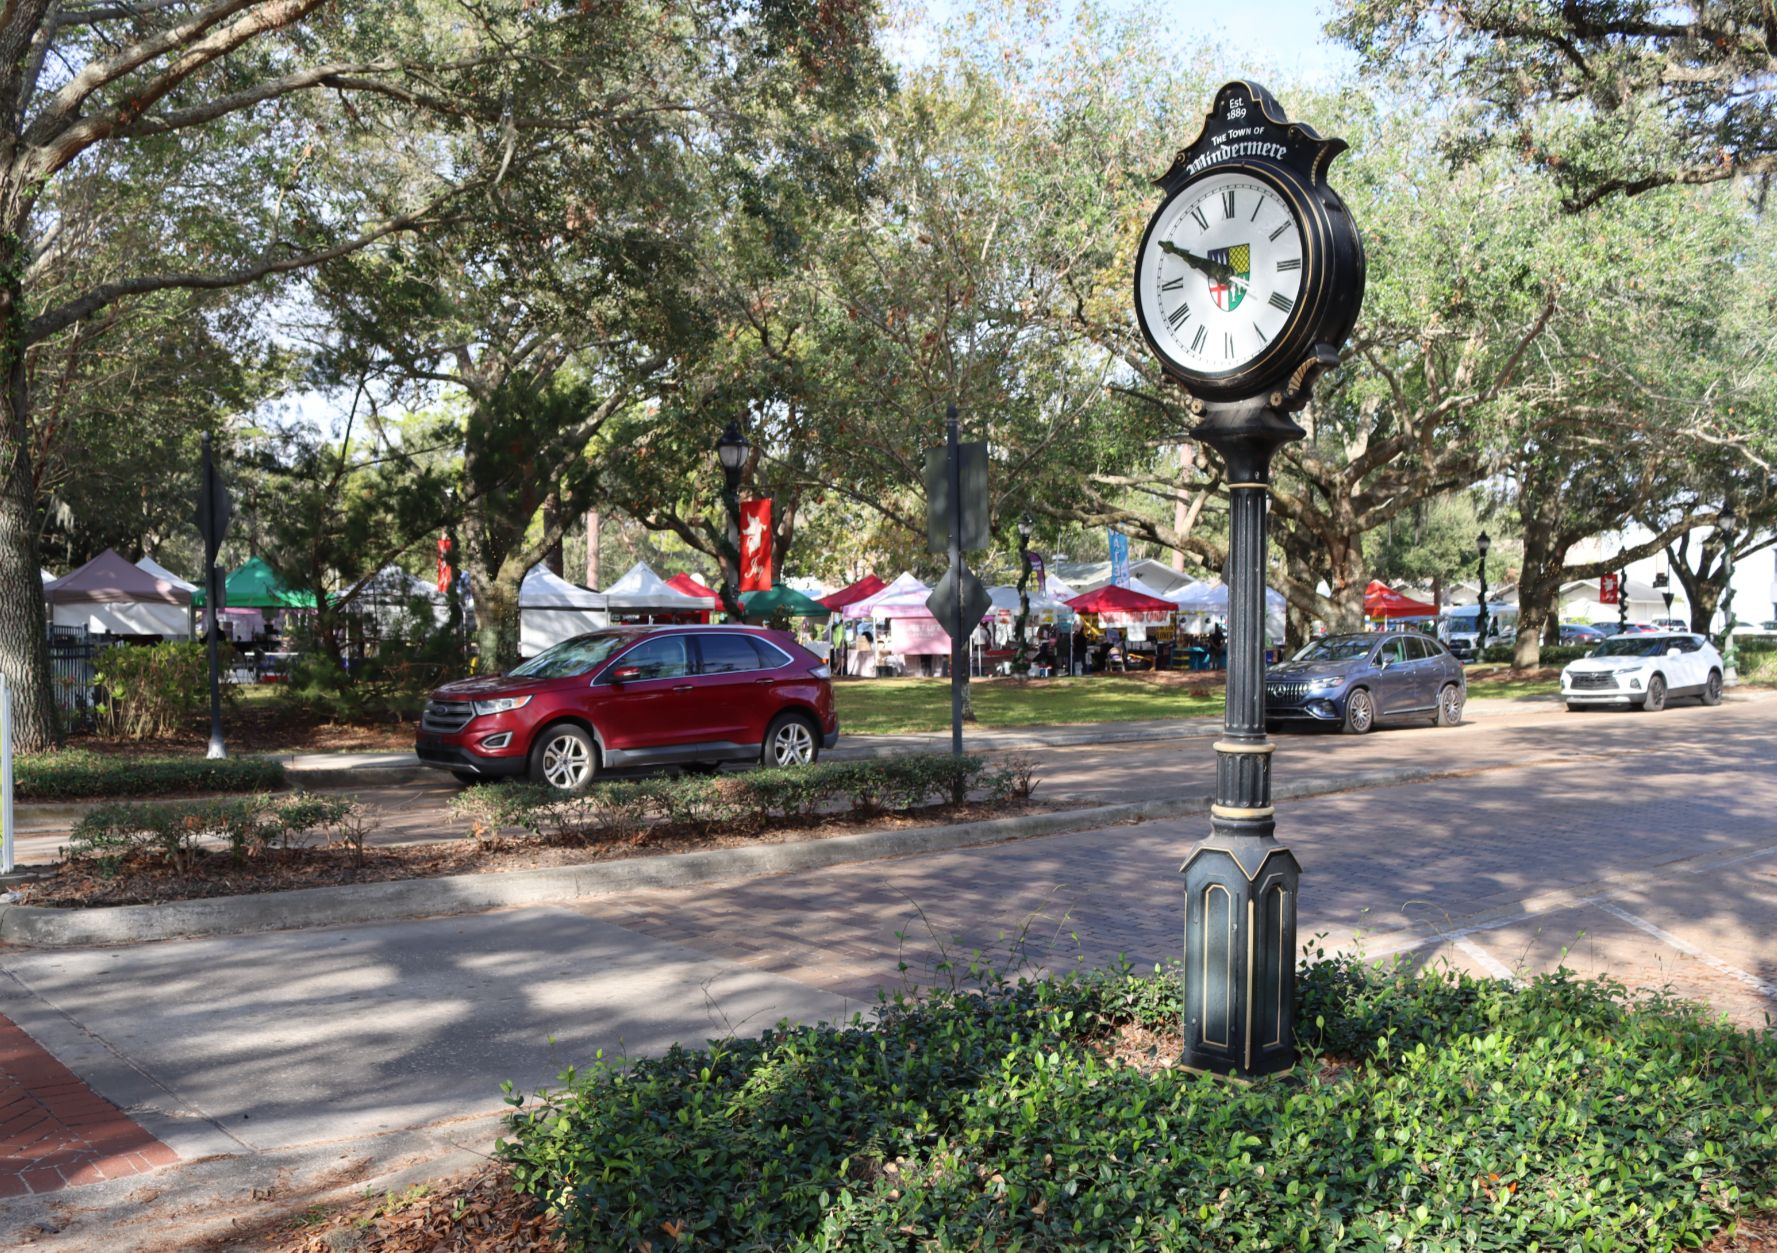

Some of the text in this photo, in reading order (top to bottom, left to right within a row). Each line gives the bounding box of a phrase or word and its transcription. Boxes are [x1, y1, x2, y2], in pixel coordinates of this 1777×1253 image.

[1229, 97, 1244, 109] Est
[1226, 108, 1247, 120] 1889
[1211, 126, 1265, 146] THE TOWN OF
